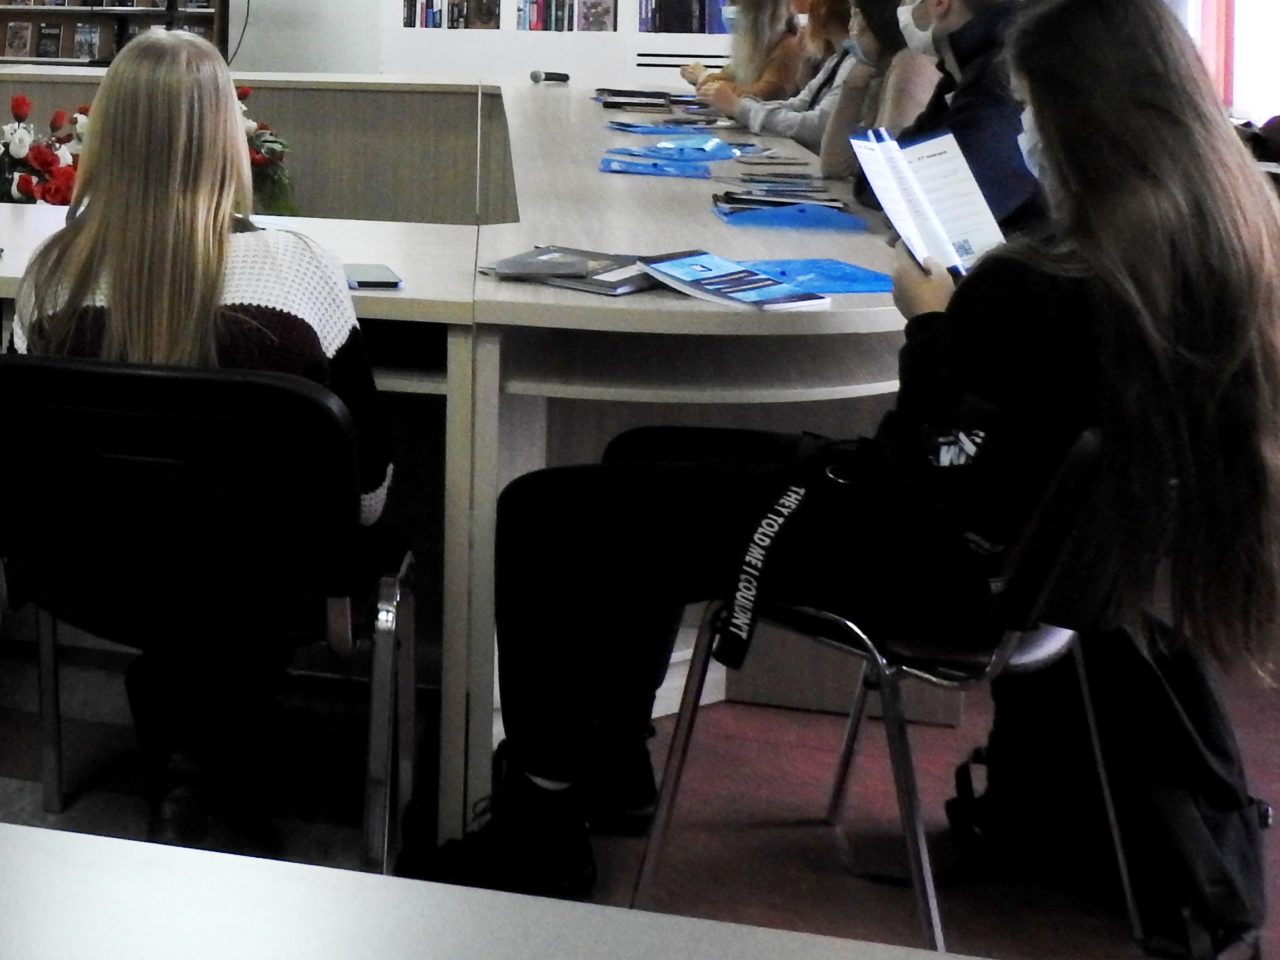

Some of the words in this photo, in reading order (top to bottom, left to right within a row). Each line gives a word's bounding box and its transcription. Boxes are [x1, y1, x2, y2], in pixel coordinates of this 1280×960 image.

[774, 486, 806, 516] THEY
[753, 513, 785, 547] TOLD
[745, 542, 767, 568] ME
[742, 565, 760, 576] I
